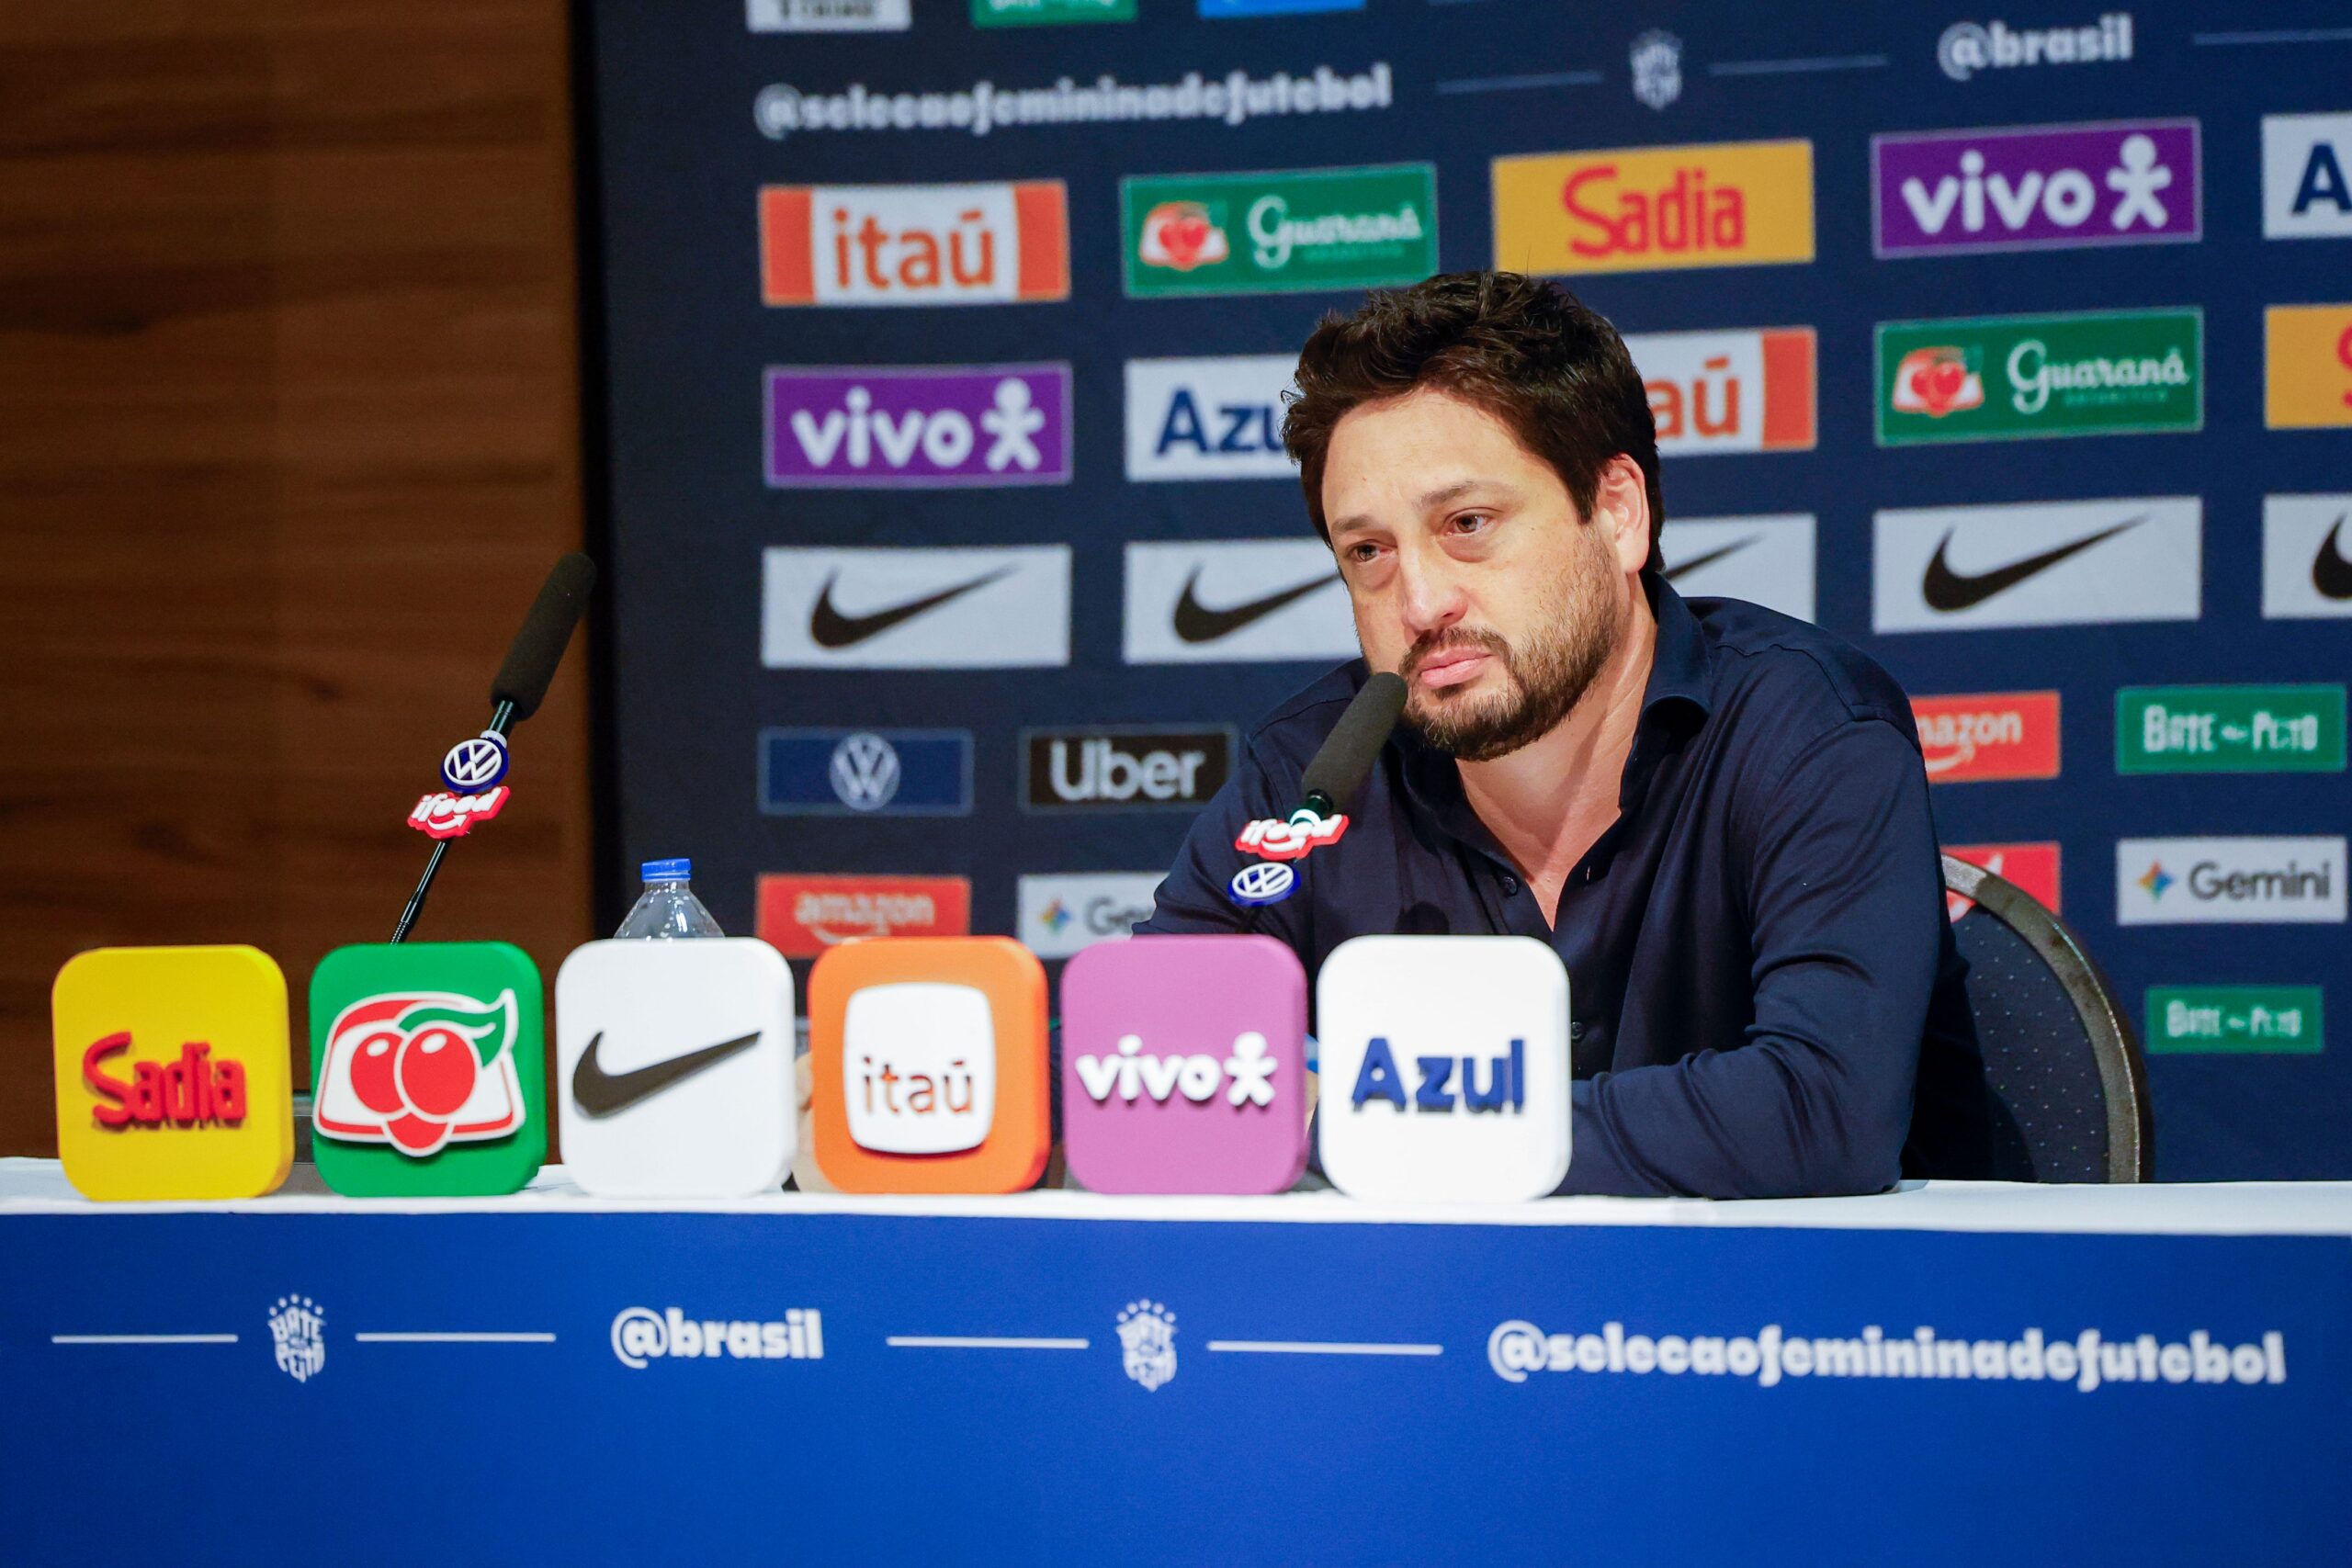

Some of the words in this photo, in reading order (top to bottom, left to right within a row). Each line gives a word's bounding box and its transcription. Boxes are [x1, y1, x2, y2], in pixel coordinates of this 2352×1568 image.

[1938, 15, 2132, 81] @brasil
[1562, 165, 1745, 258] Sadia
[1902, 151, 2095, 233] vivo
[833, 209, 994, 289] itaú
[1645, 355, 1739, 439] aú
[2007, 339, 2190, 414] Guaraná
[791, 387, 974, 468] vivo
[1156, 389, 1284, 455] Azu
[1048, 740, 1204, 801] Uber
[794, 893, 935, 928] amazon
[2190, 861, 2331, 901] Gemini
[83, 1031, 246, 1130] Sadia
[862, 1057, 974, 1114] itaú
[1076, 1034, 1222, 1103] vivo
[1351, 1037, 1526, 1113] Azul
[611, 1306, 823, 1369] @brasil
[1487, 1319, 2287, 1393] @selecaofemininadefutebol
